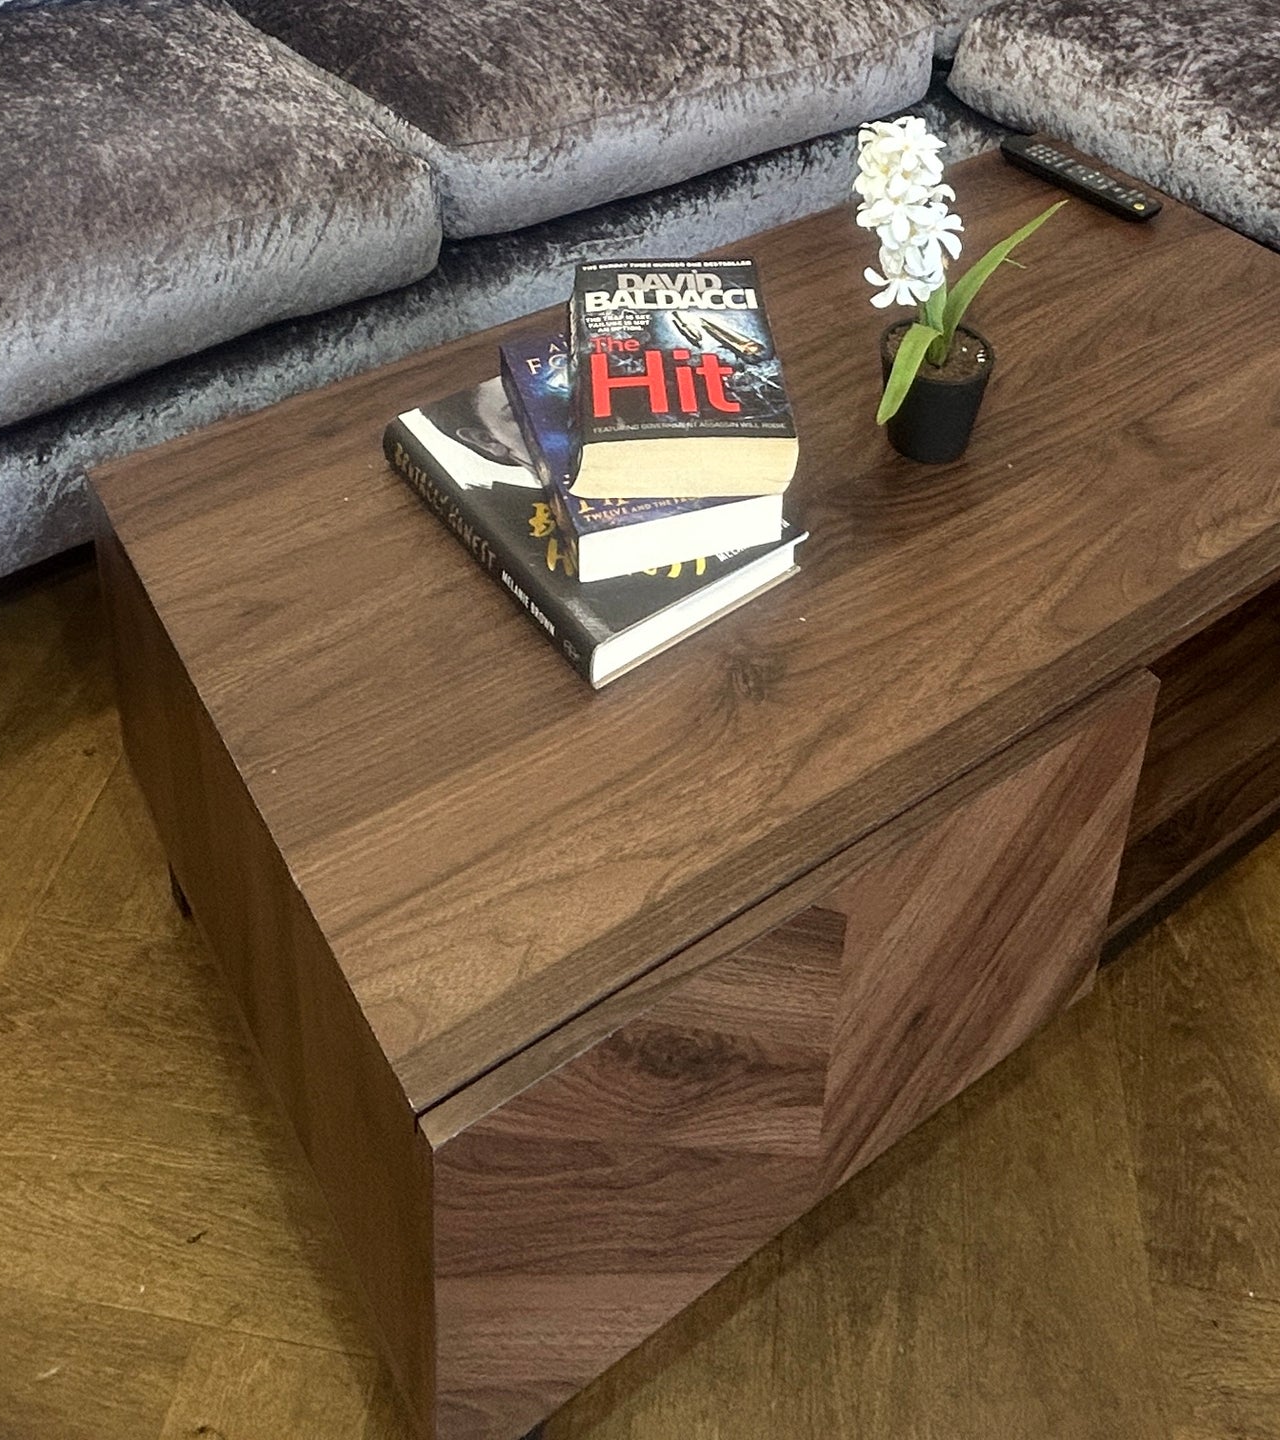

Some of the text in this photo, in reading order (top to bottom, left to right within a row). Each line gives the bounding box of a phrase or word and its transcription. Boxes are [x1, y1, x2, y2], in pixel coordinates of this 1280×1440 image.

[617, 271, 722, 292] DAVID
[585, 288, 758, 312] BALDACCI
[590, 336, 640, 353] The
[590, 348, 741, 418] Hit
[583, 506, 627, 522] TWELVE
[631, 503, 651, 513] AND
[653, 500, 670, 508] THE
[502, 570, 555, 637] MELANIE BROWN
